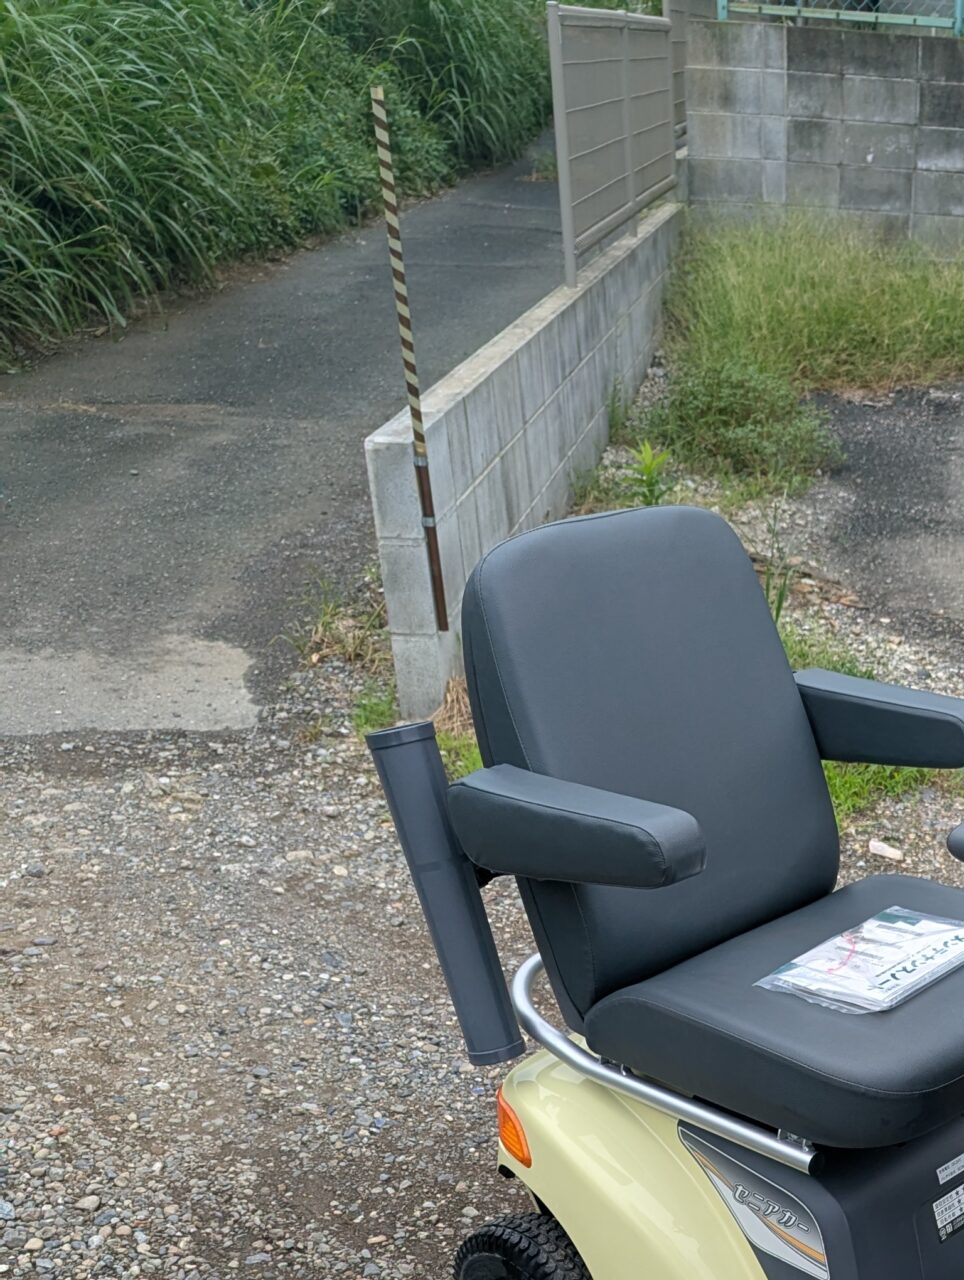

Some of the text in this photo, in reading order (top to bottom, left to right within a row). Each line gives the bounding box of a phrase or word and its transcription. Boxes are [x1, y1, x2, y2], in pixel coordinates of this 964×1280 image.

[733, 1183, 810, 1232] セニアカー
